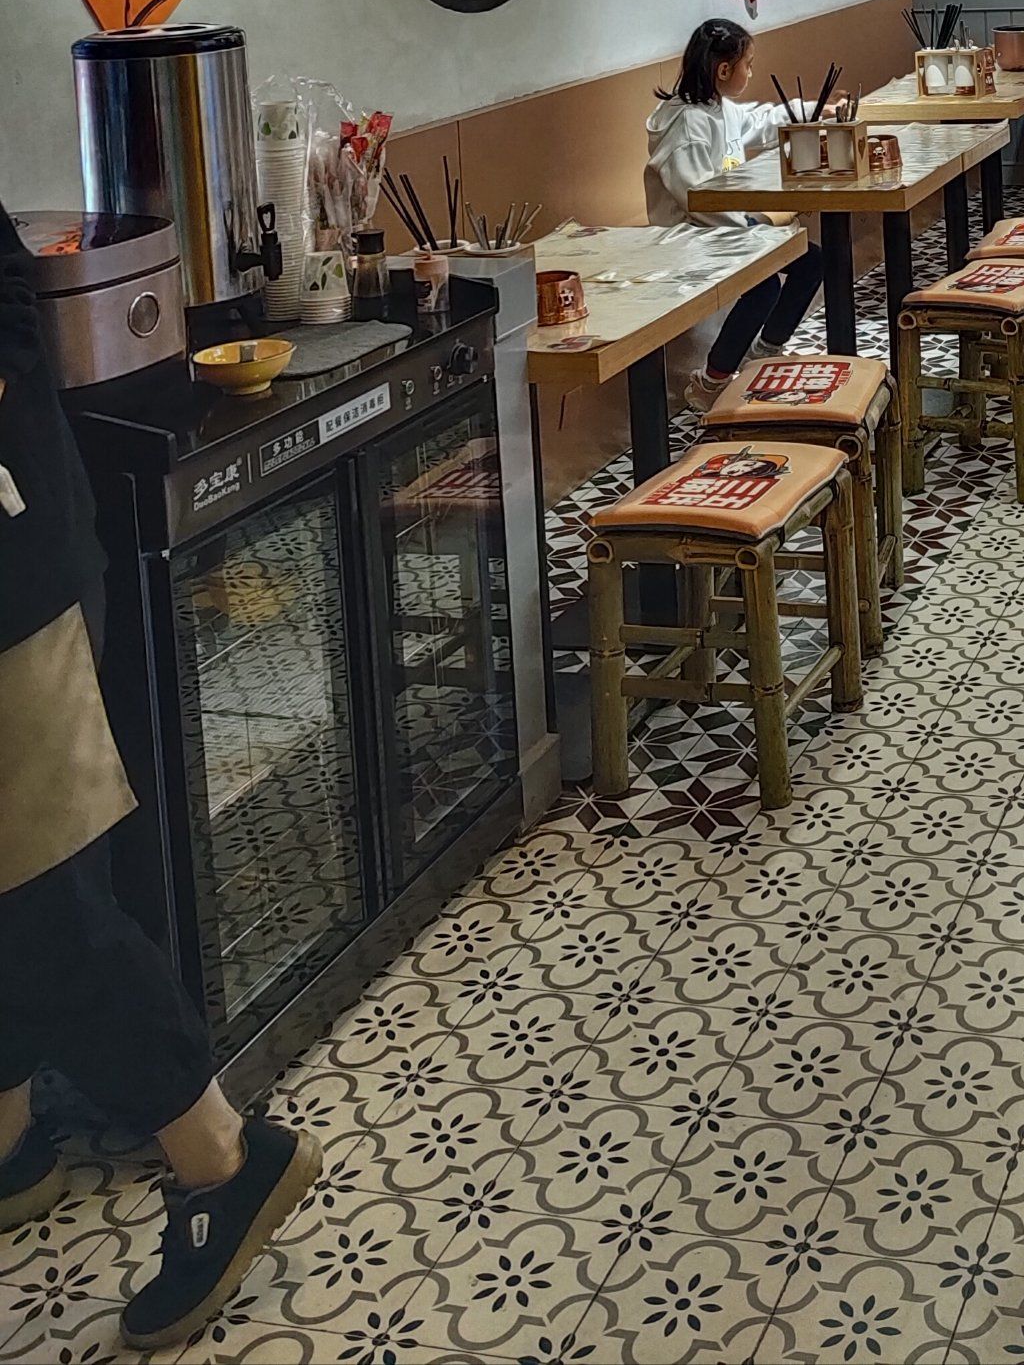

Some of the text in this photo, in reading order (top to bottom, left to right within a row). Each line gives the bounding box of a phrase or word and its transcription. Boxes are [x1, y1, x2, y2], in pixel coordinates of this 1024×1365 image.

[272, 430, 304, 457] 多功能
[193, 462, 240, 501] 多宝康
[193, 482, 240, 512] DuoBaoKang
